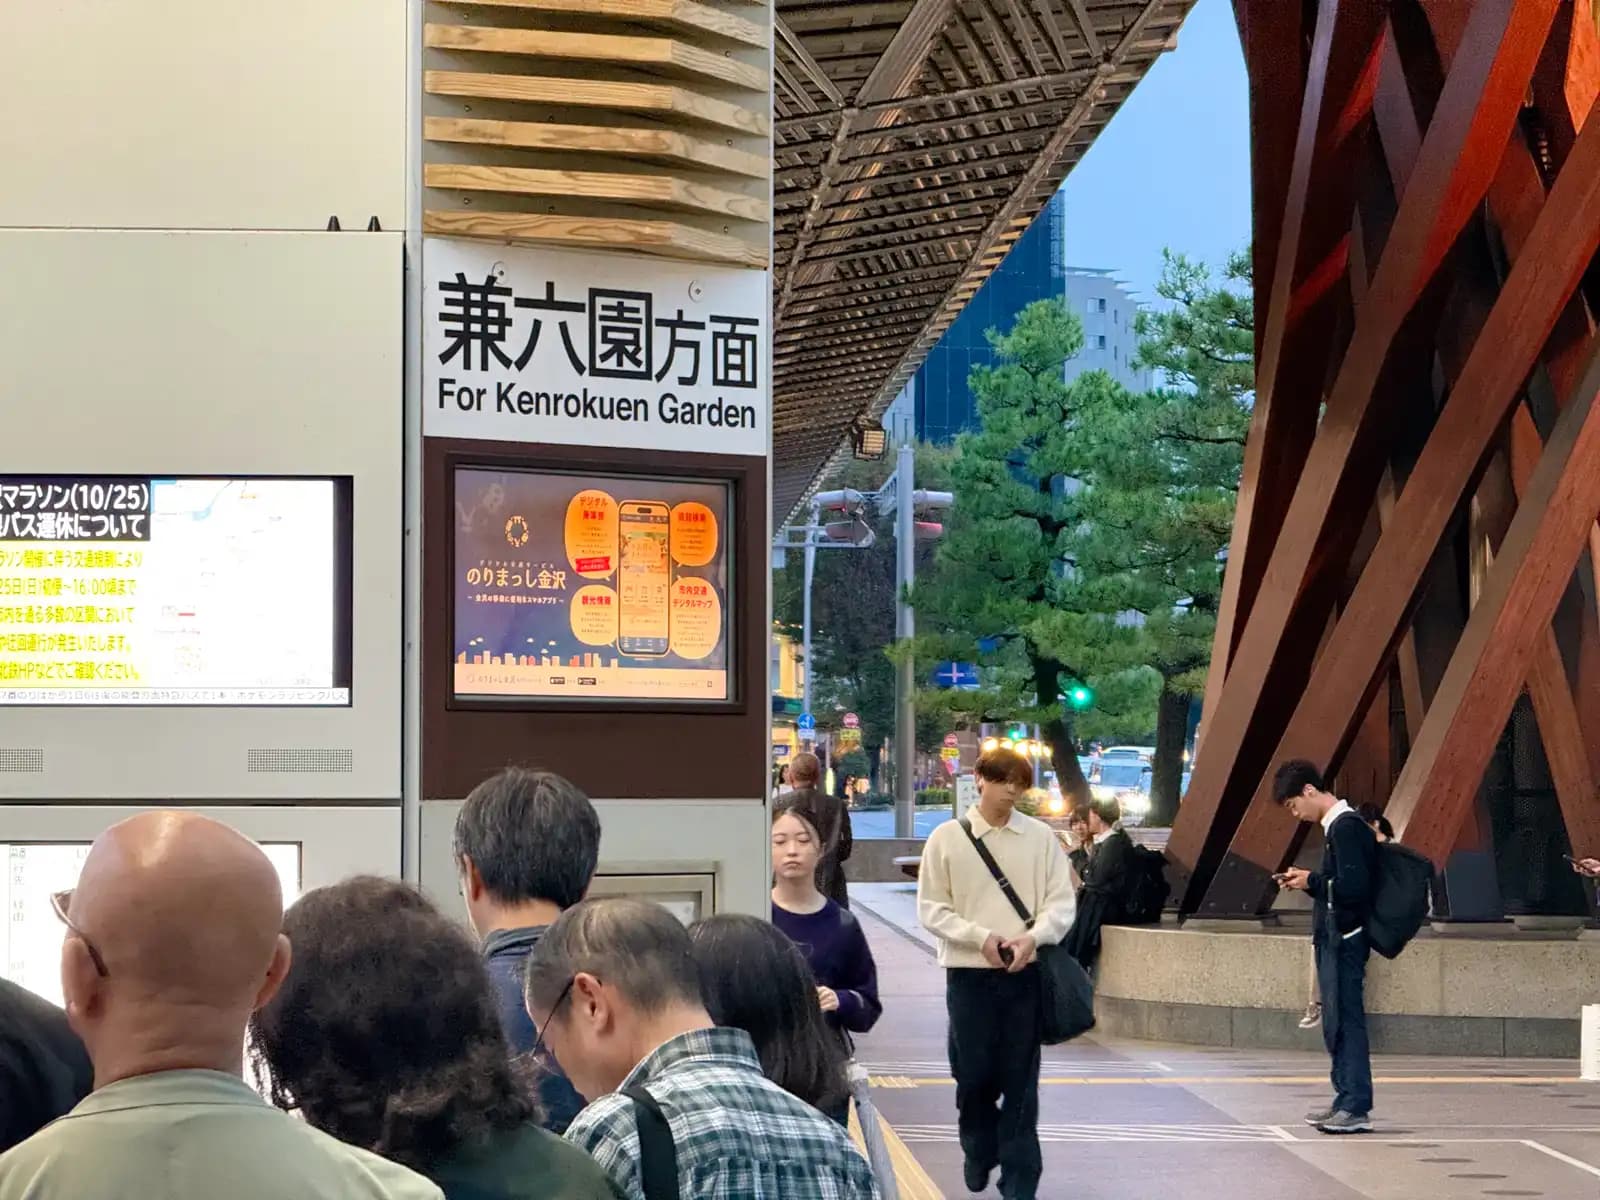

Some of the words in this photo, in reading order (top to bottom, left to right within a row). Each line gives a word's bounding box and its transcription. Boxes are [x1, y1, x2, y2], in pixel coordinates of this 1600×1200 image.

[438, 272, 760, 389] 兼六園方面
[438, 378, 487, 412] For
[496, 381, 649, 422] Kenrokuen
[657, 392, 756, 428] Garden
[0, 484, 149, 511] マラソン(10/25)
[0, 512, 146, 539] バス運休について
[466, 567, 567, 590] のりまっし金沢
[672, 598, 713, 609] デジタルマップ
